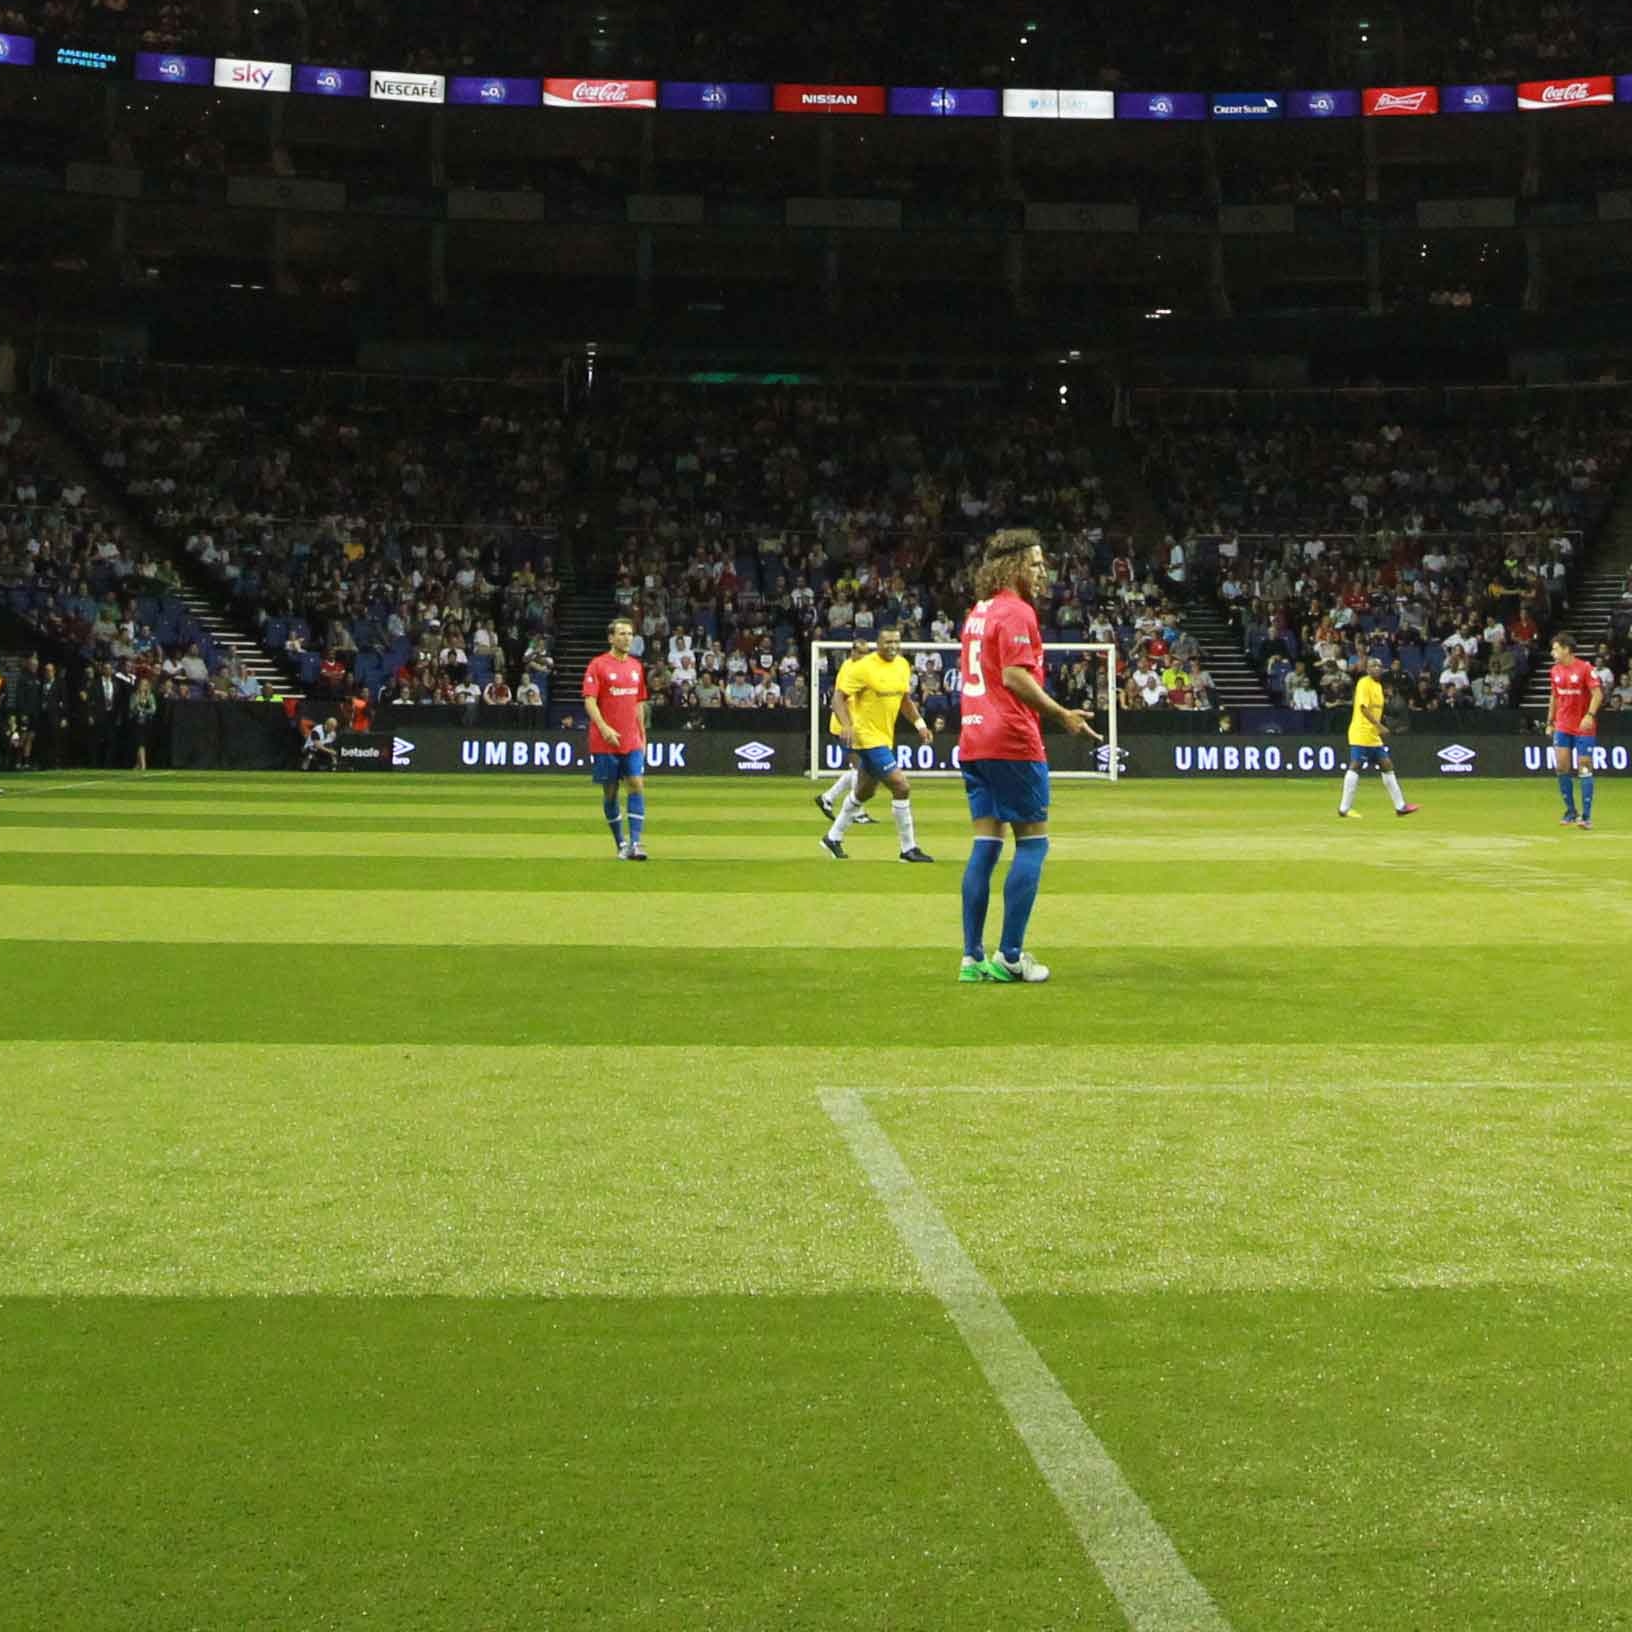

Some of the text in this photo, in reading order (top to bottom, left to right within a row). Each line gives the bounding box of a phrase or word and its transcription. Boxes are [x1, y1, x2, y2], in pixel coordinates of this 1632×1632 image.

[56, 47, 118, 63] AMERICAN
[232, 63, 274, 88] sky
[801, 93, 858, 105] NISSAN
[962, 639, 987, 697] 5
[462, 741, 686, 767] UMBRO.UK
[1175, 745, 1389, 770] UMBRO.CO.
